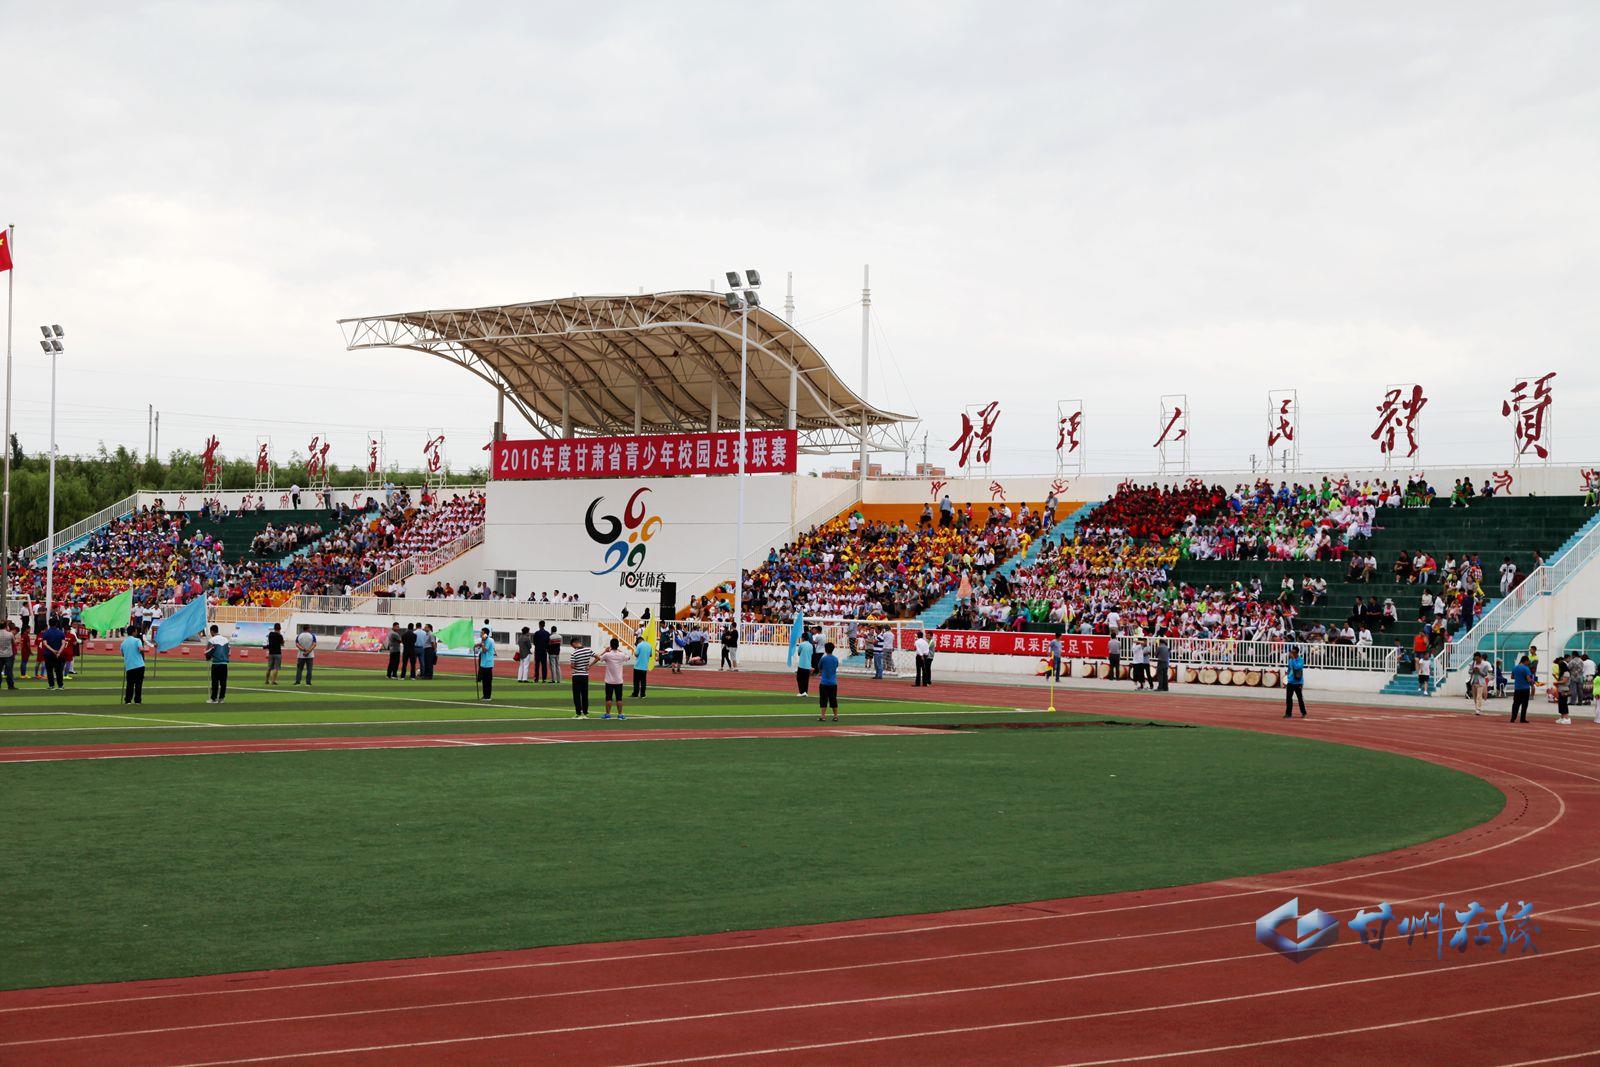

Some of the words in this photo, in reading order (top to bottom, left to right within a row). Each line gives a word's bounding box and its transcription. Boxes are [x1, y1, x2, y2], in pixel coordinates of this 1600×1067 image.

[501, 436, 787, 472] 2016年度甘肃省青少年校园足球联赛
[620, 571, 666, 589] 阳光体育
